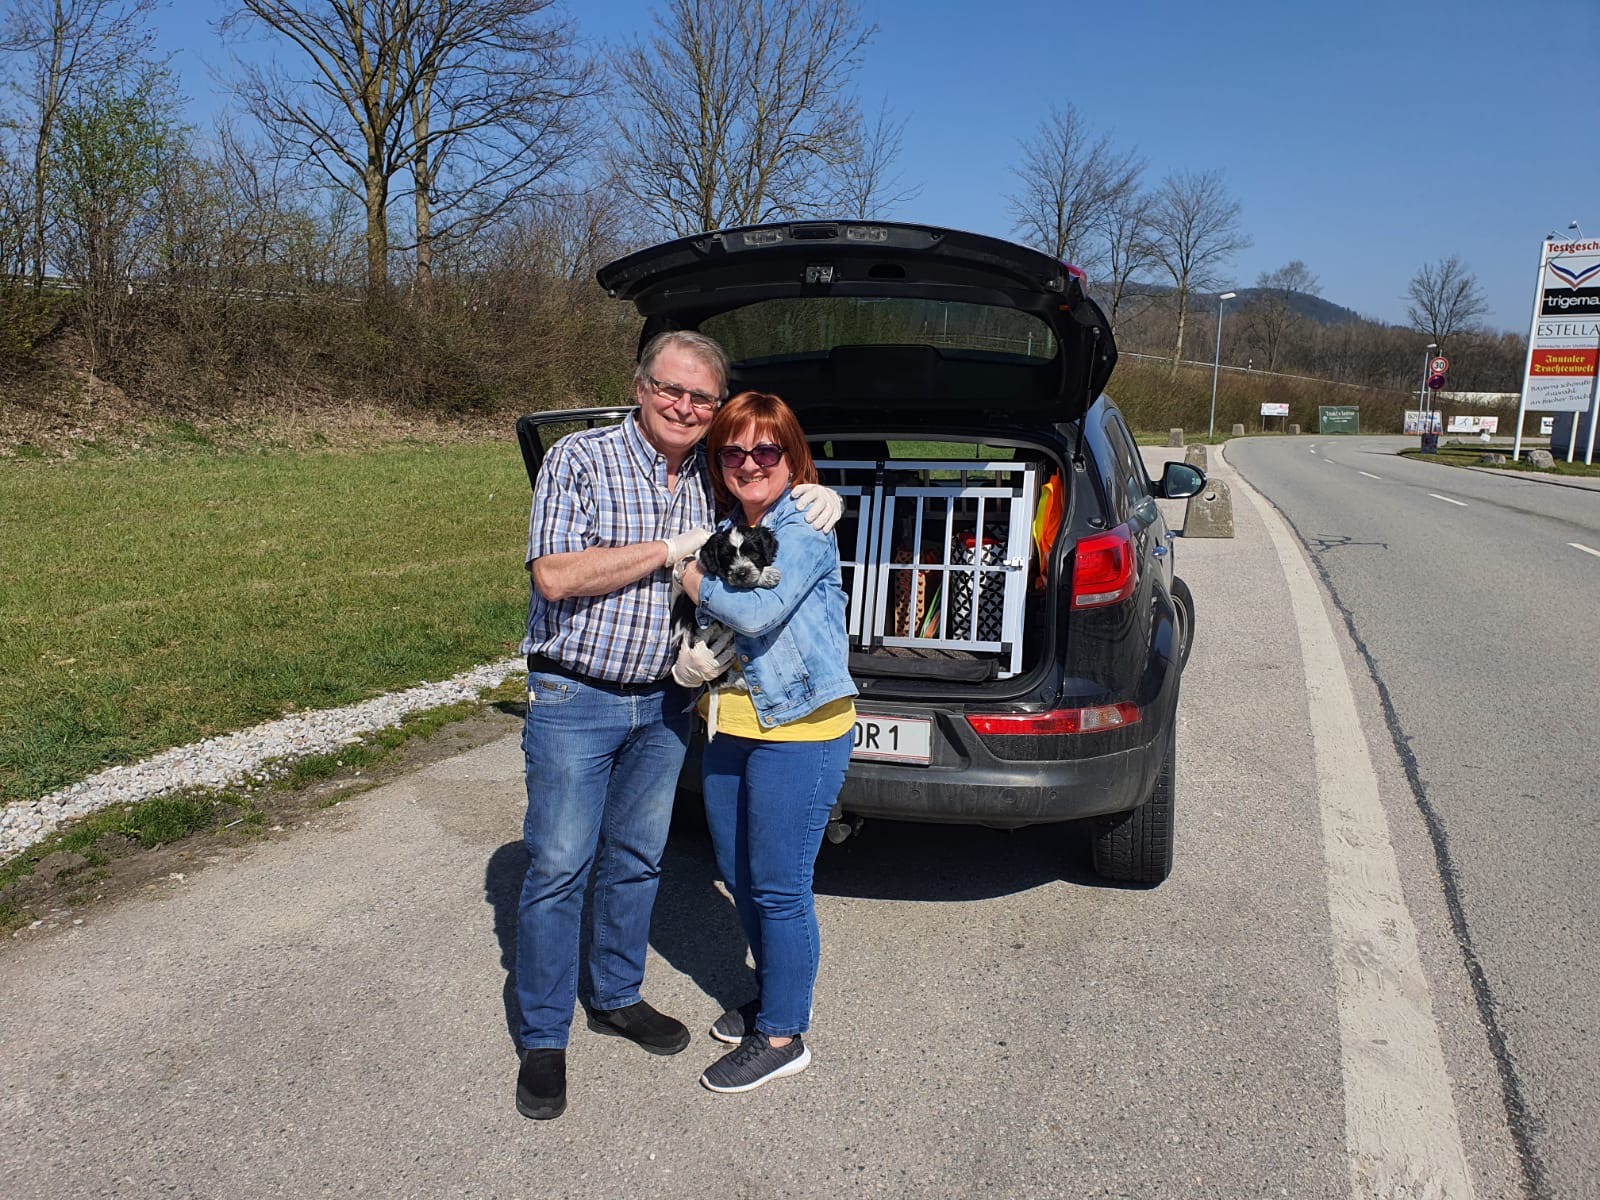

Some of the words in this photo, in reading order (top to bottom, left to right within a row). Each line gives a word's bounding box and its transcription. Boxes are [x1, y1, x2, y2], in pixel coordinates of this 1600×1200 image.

[1547, 241, 1600, 254] Testgesch
[1548, 295, 1600, 309] trigema
[1537, 322, 1600, 336] ESTELLA
[1434, 361, 1445, 370] 30
[888, 724, 898, 751] 1
